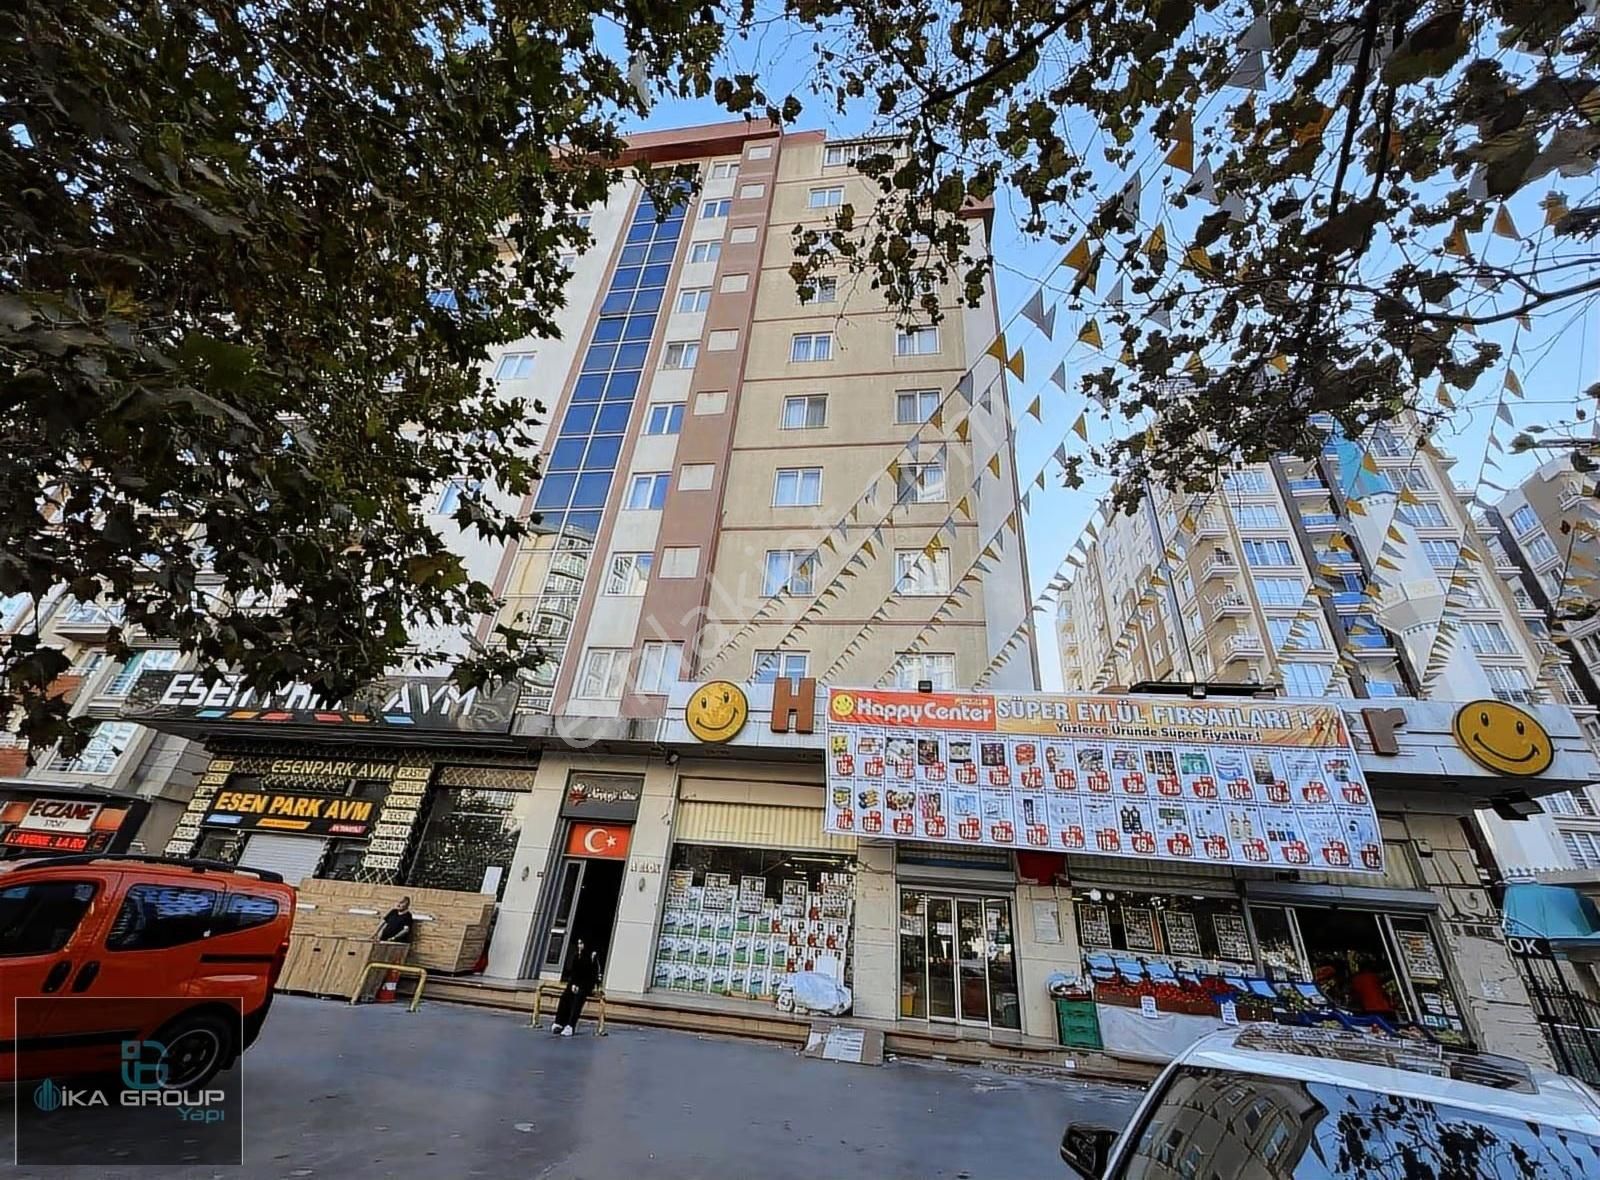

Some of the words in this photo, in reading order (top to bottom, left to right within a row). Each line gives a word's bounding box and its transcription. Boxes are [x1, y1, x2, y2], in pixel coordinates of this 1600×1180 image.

[381, 682, 478, 716] AVM
[997, 696, 1071, 721] SÜPER
[1077, 700, 1147, 724] EYLÜL
[1152, 704, 1292, 730] FIRSATLARI
[1056, 722, 1108, 736] Yüzlerce
[1111, 723, 1158, 738] Üründe
[1160, 726, 1200, 741] Süper
[271, 759, 356, 776] ESENPARK
[356, 763, 395, 779] AVM
[29, 800, 95, 820] ECZANE
[214, 792, 270, 814] ESEN
[268, 796, 324, 819] PARK
[323, 800, 374, 821] AVM
[1508, 937, 1542, 955] OK
